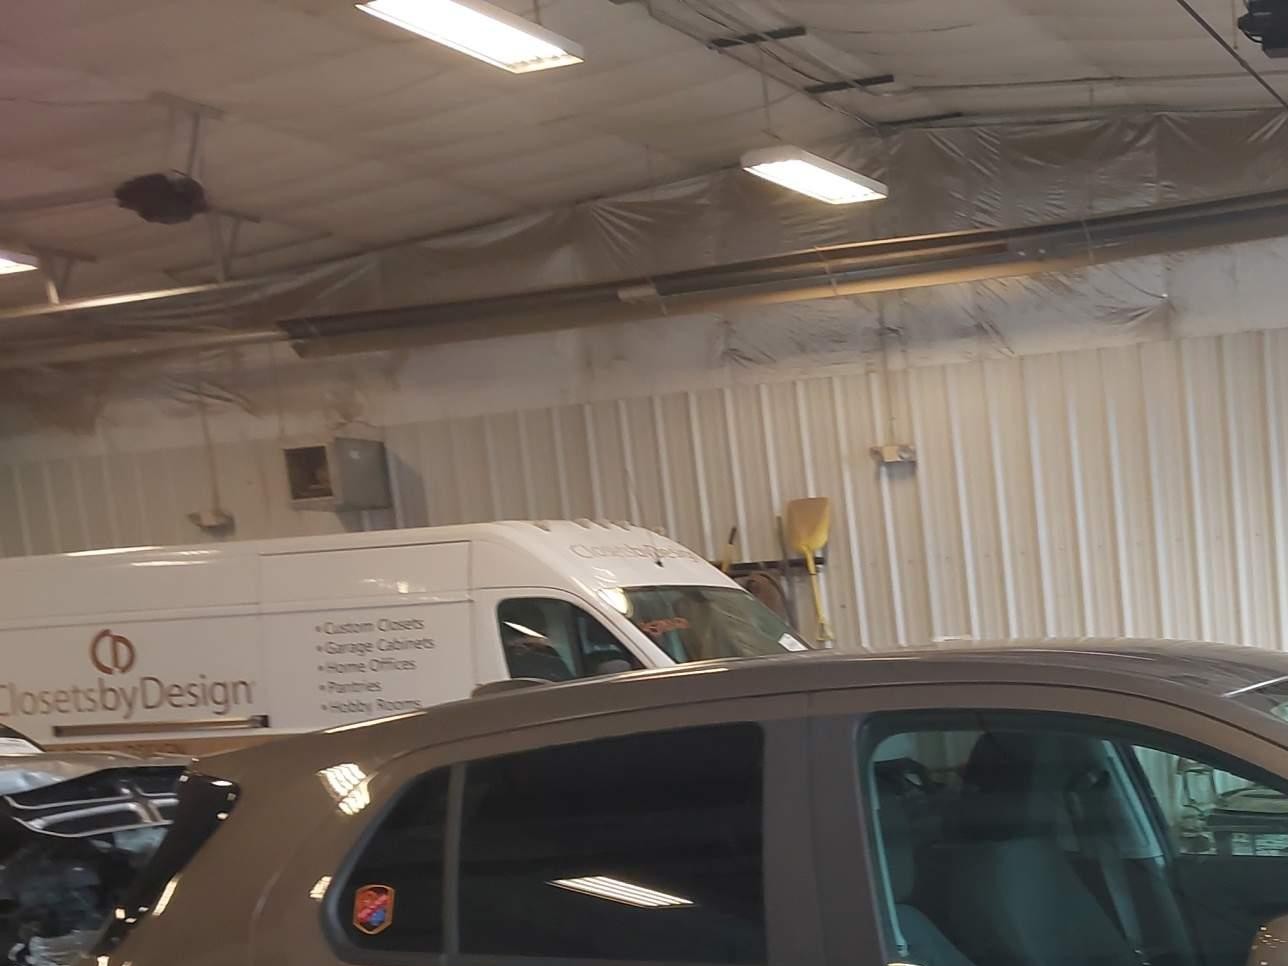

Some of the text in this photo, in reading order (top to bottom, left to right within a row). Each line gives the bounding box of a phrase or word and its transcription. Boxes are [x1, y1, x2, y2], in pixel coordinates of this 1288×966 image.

[325, 618, 425, 635] Custom Closets
[326, 637, 435, 656] Garage Cabinets
[327, 657, 417, 674] Home Offices
[328, 680, 382, 693] Pantries
[330, 698, 422, 715] Hobby Rooms
